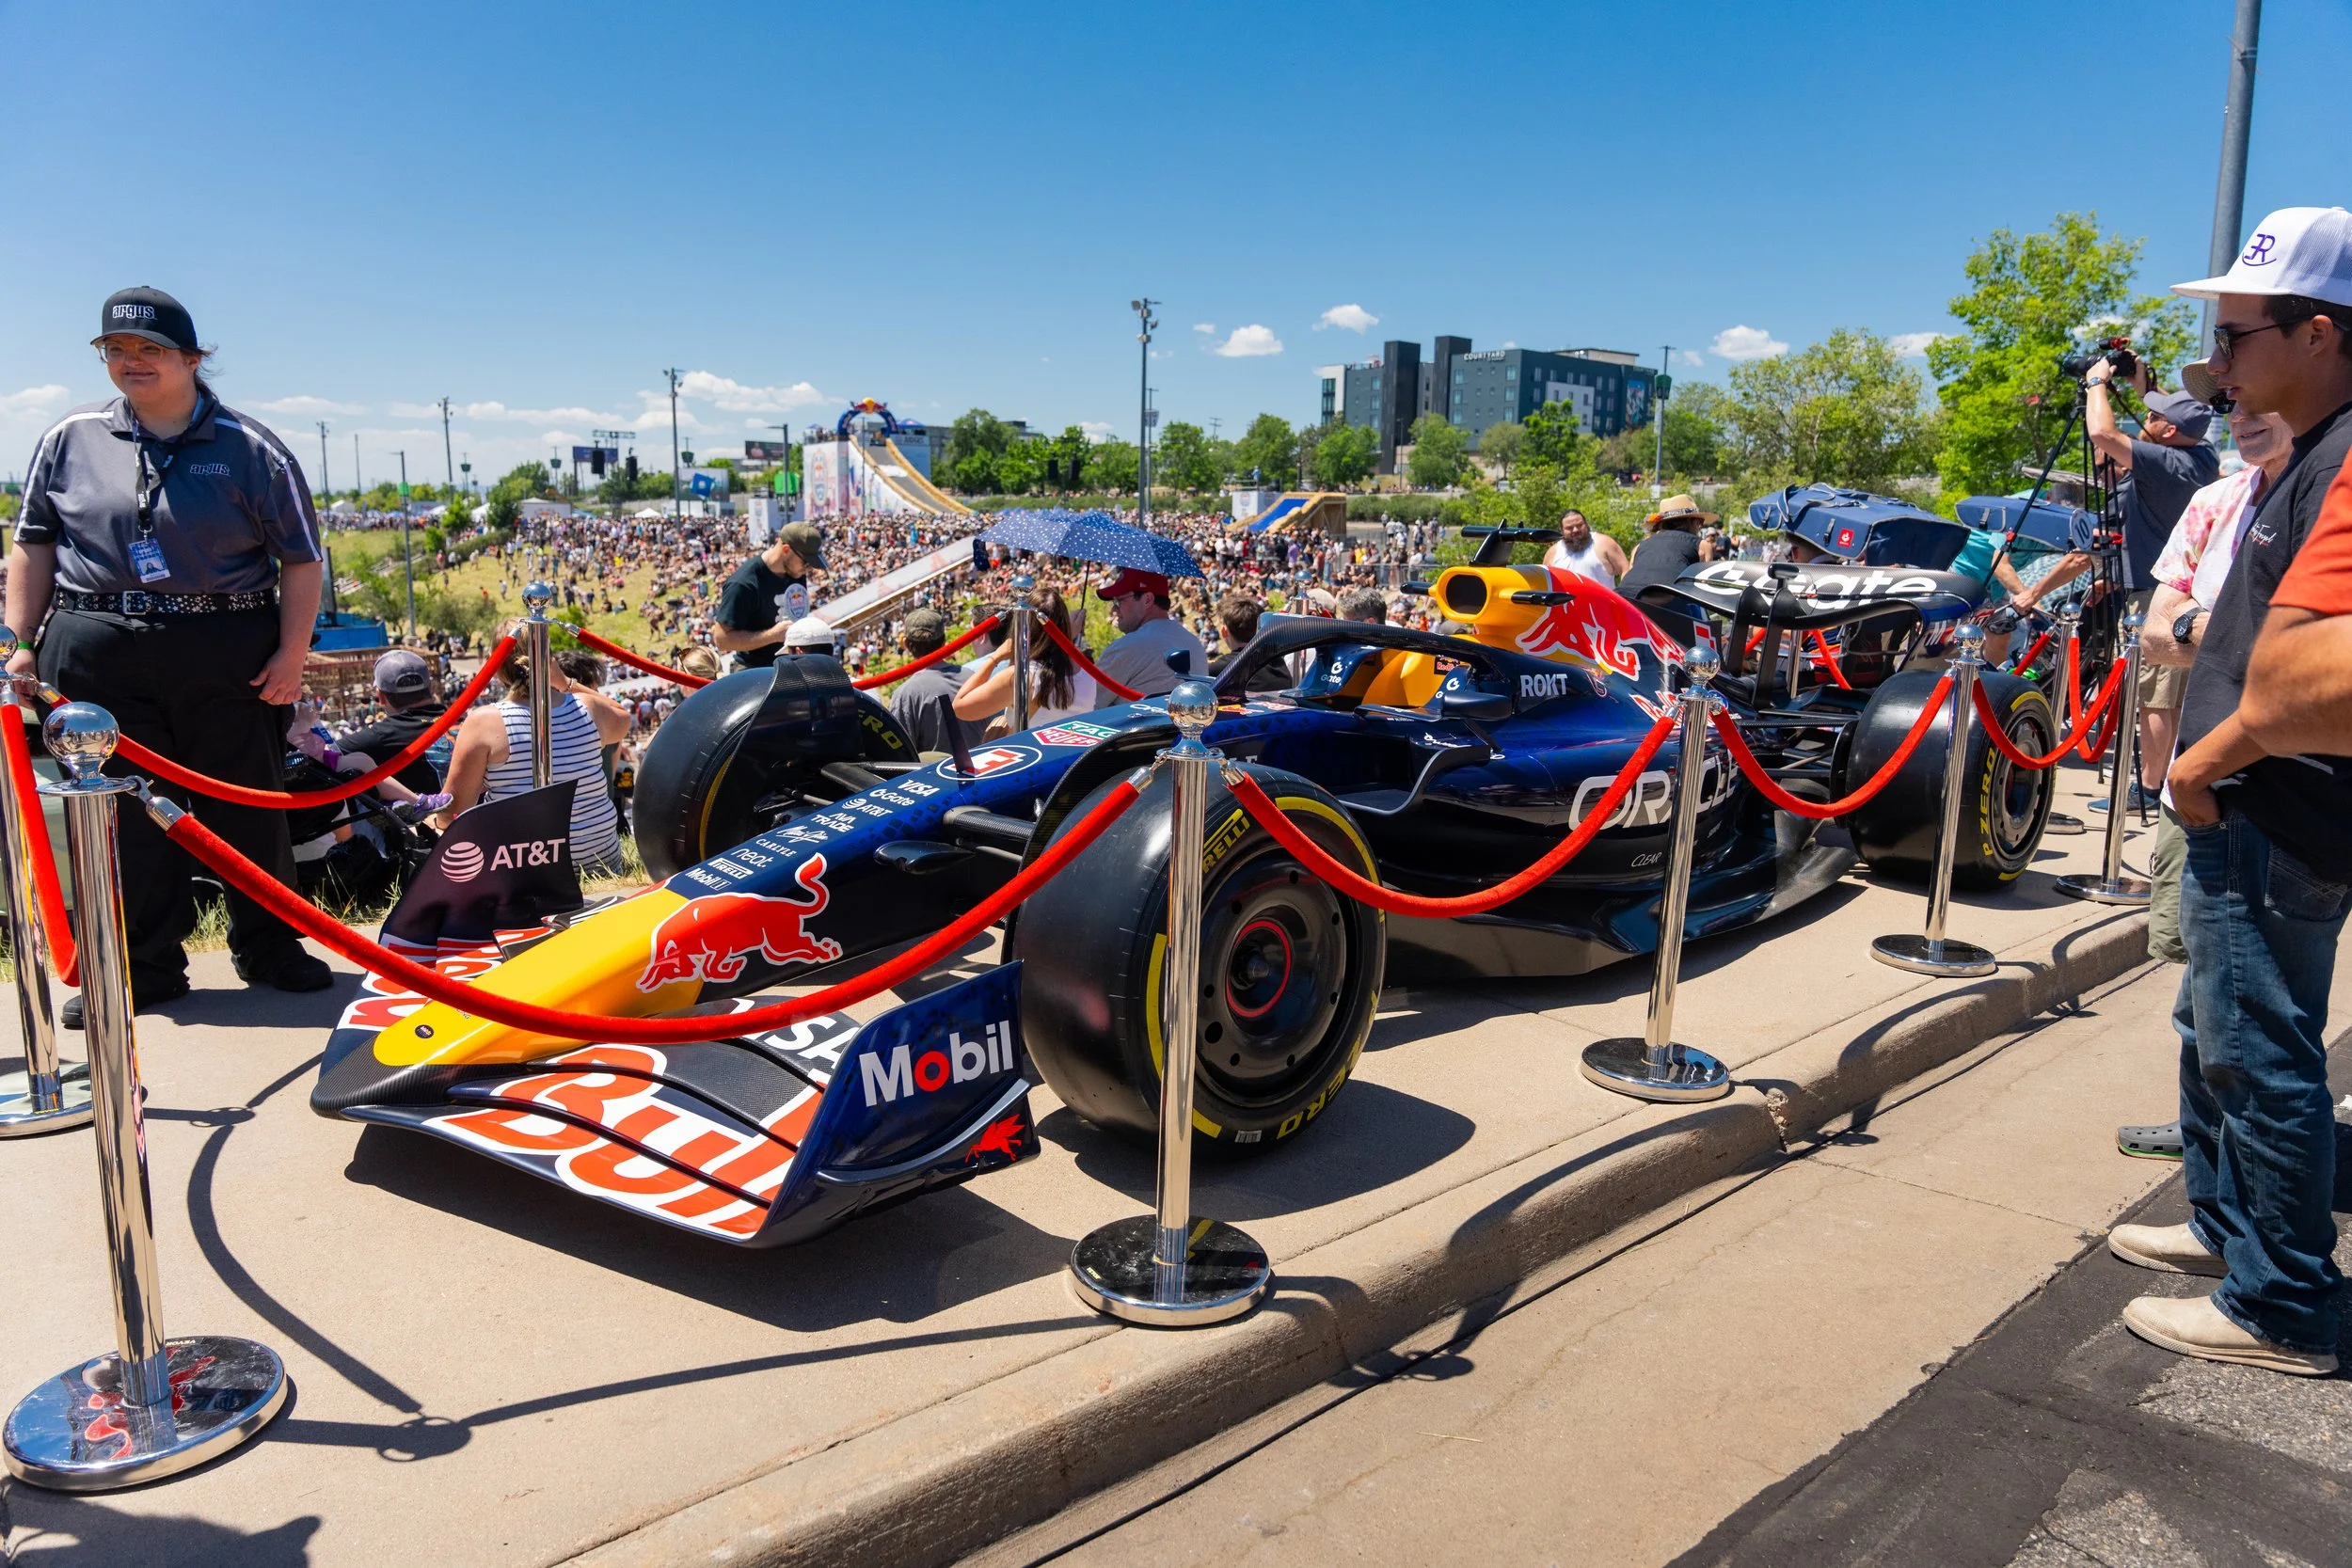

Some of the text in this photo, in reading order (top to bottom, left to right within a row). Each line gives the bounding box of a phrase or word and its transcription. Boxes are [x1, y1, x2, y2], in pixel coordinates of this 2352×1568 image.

[112, 304, 154, 319] argus
[1464, 350, 1505, 361] COURTYARD
[2074, 518, 2090, 545] 10
[1321, 673, 1343, 684] Gate
[1520, 673, 1568, 697] ROKT
[1040, 728, 1103, 746] HEUER
[1071, 721, 1121, 737] TAG
[898, 779, 940, 798] VISA
[1568, 749, 1740, 831] ORCLE
[1979, 747, 1996, 835] ZERO
[882, 791, 915, 806] Gate
[829, 812, 856, 824] AVA
[857, 803, 893, 817] AT&T
[811, 814, 855, 832] TRADE
[755, 838, 798, 858] CARLYLE
[1202, 808, 1251, 874] RELLI
[1982, 843, 1994, 856] P
[490, 838, 565, 871] AT&T
[730, 848, 774, 867] neat.
[1631, 851, 1662, 867] CLEAR
[707, 857, 755, 879] PIRELLI
[685, 867, 718, 889] Mobil
[859, 1020, 1014, 1107] Mobil
